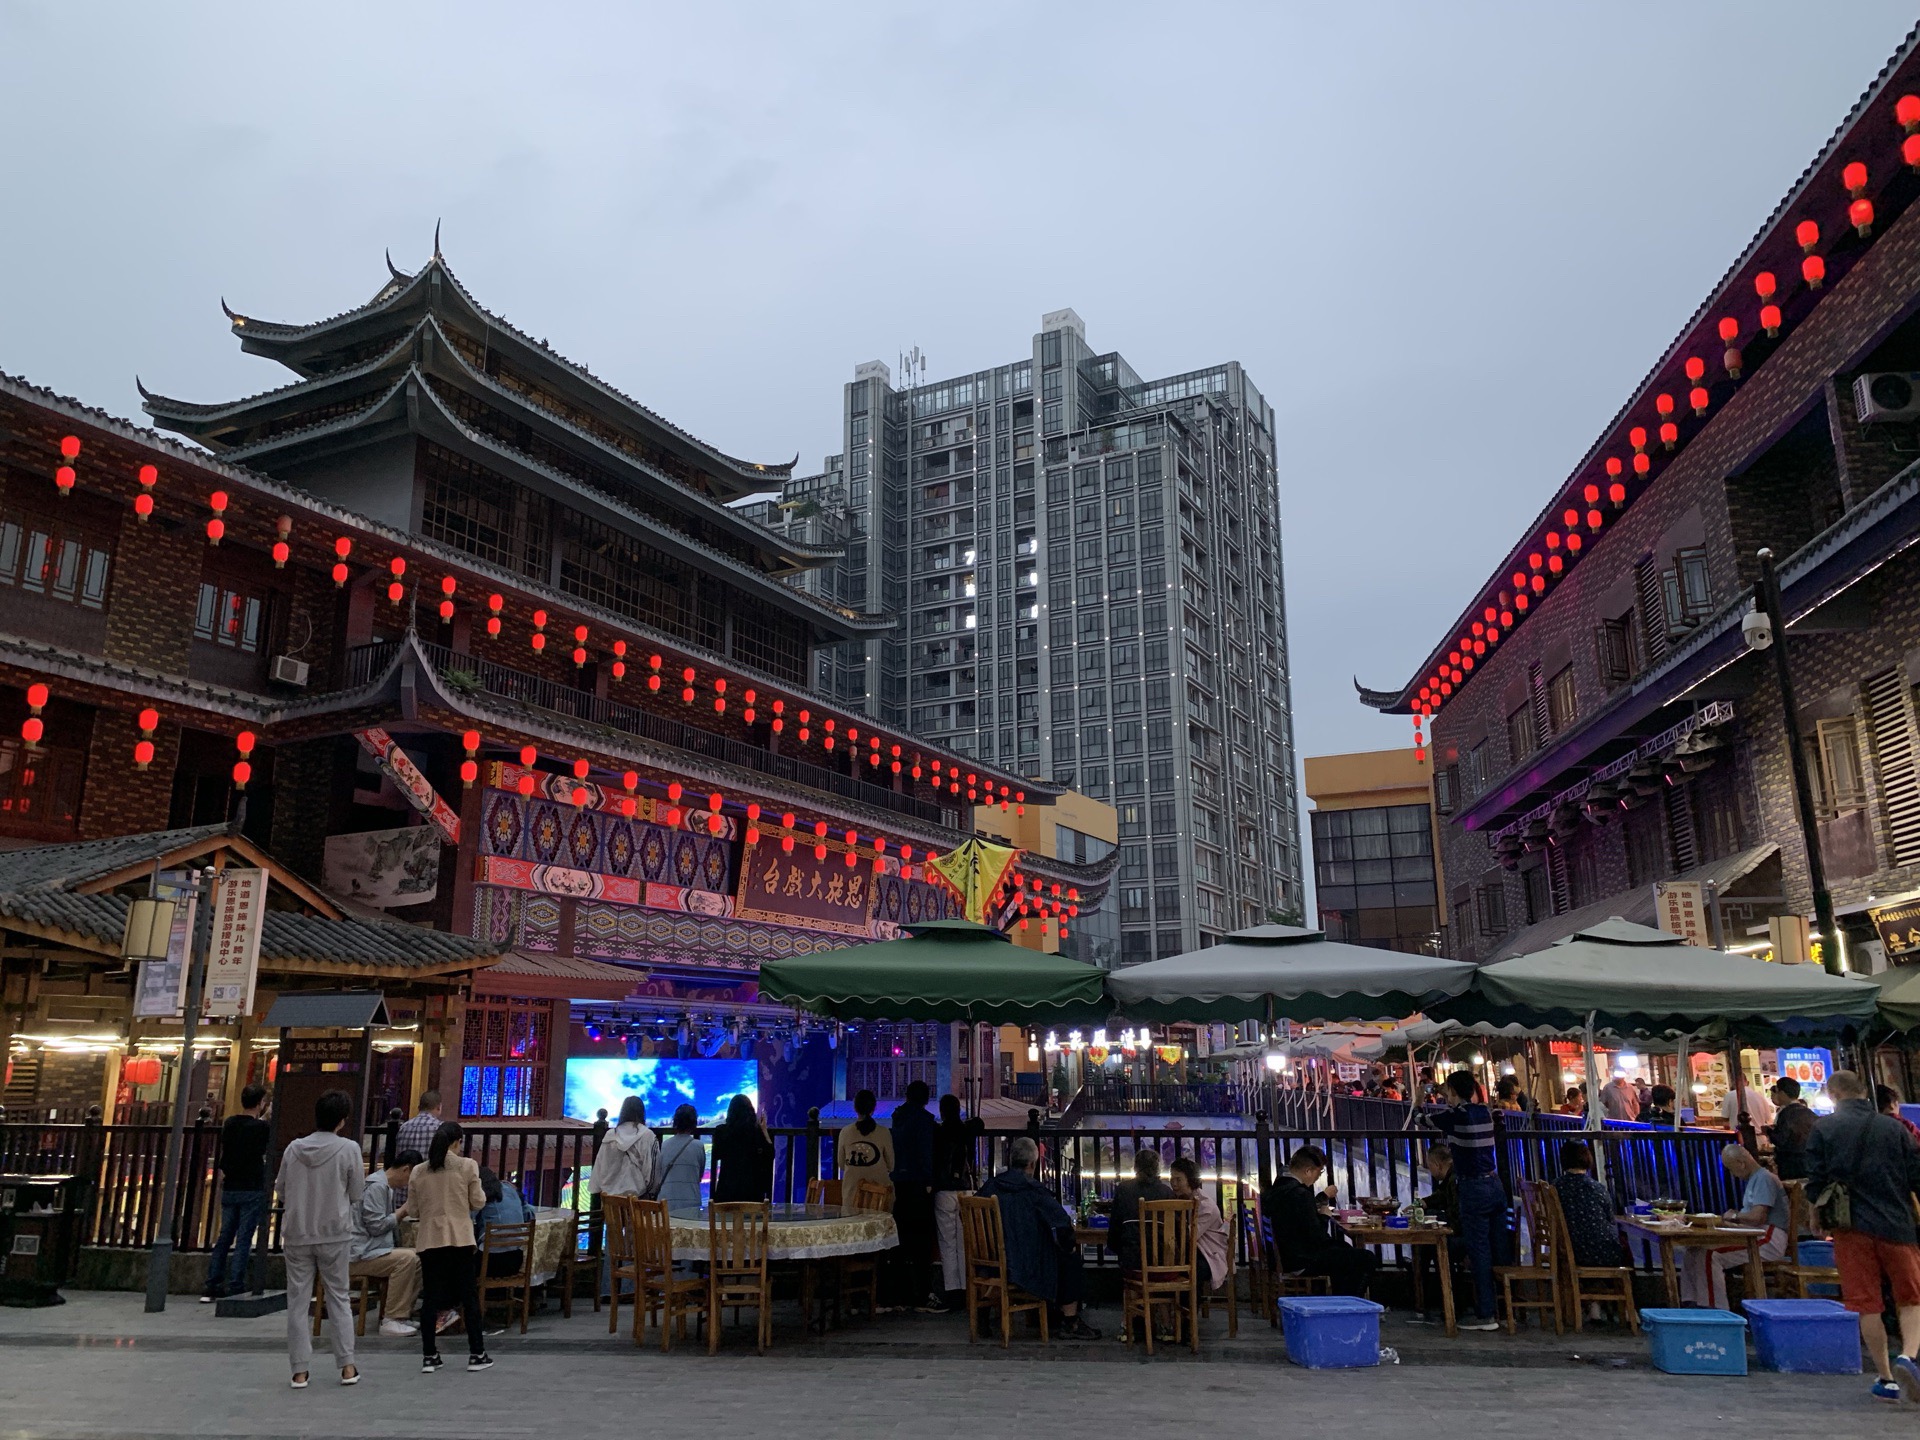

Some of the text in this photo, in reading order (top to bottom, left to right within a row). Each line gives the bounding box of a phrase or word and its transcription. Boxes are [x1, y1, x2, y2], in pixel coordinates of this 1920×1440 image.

[218, 880, 238, 965] 游乐恩施旅游接待中心
